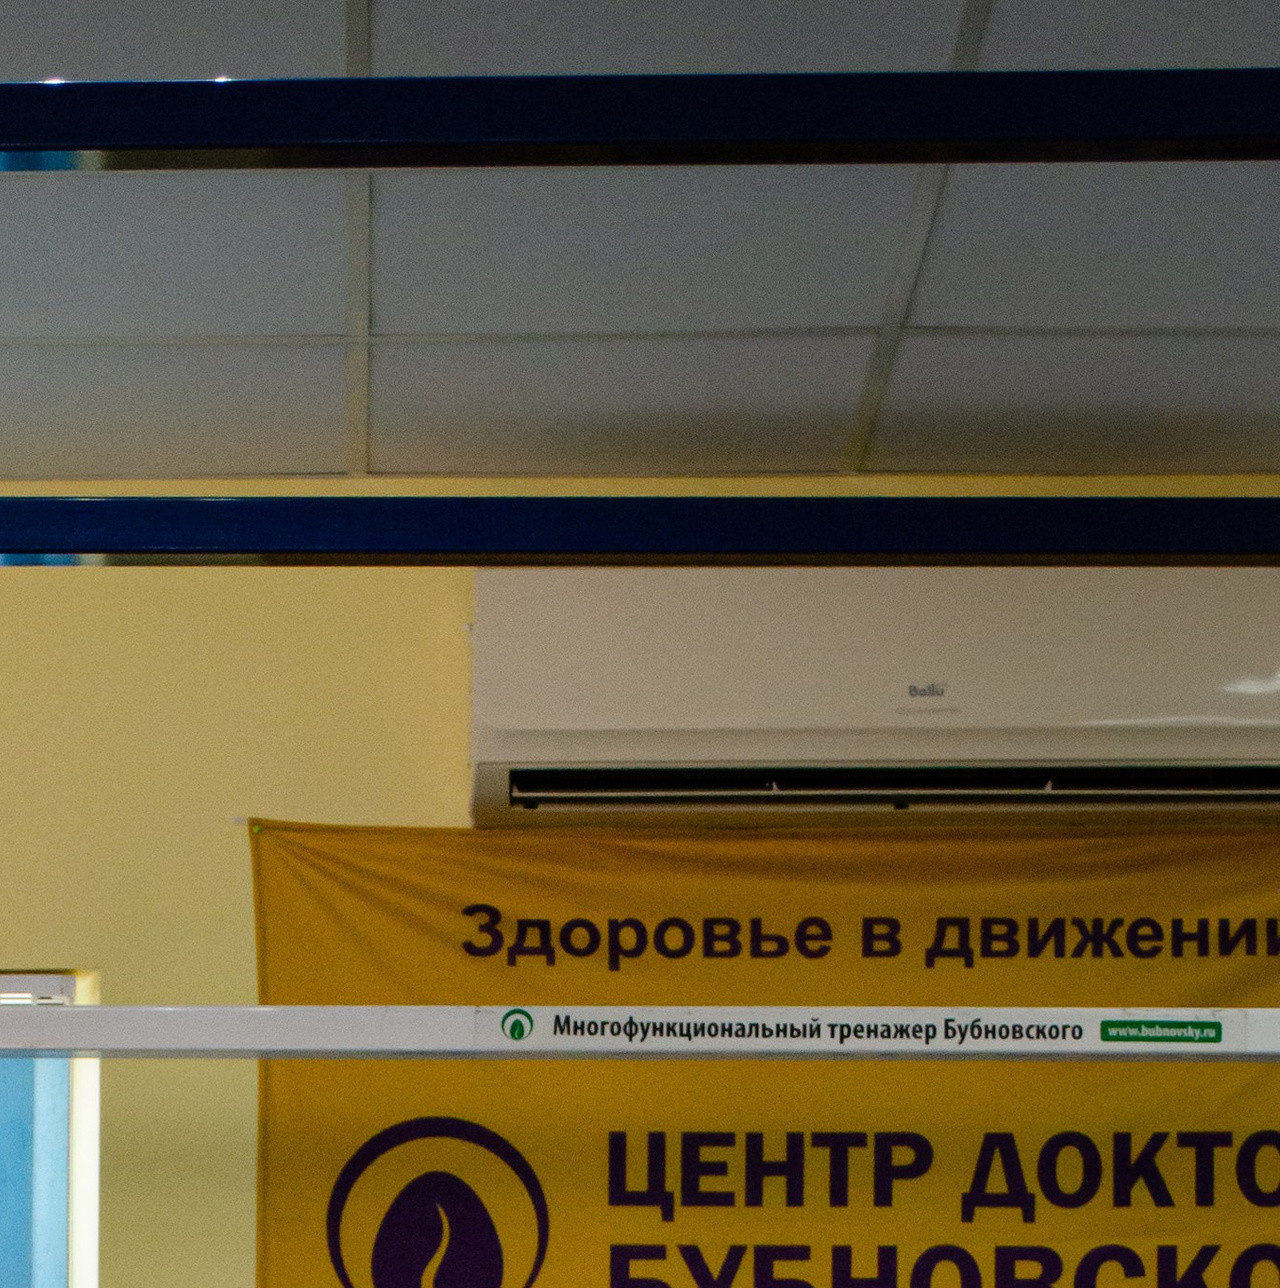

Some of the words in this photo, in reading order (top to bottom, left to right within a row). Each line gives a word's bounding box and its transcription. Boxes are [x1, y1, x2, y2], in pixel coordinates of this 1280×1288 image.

[460, 903, 833, 972] Здоровье
[861, 916, 903, 959] в
[552, 1013, 821, 1044] Многофункциональный
[827, 1019, 936, 1046] тренажер
[943, 1018, 1084, 1045] Бубновского
[1106, 1023, 1217, 1041] www.bubnovsky.ru
[607, 1130, 935, 1222] ЦЕНТР
[960, 1130, 1280, 1223] ДОКТО
